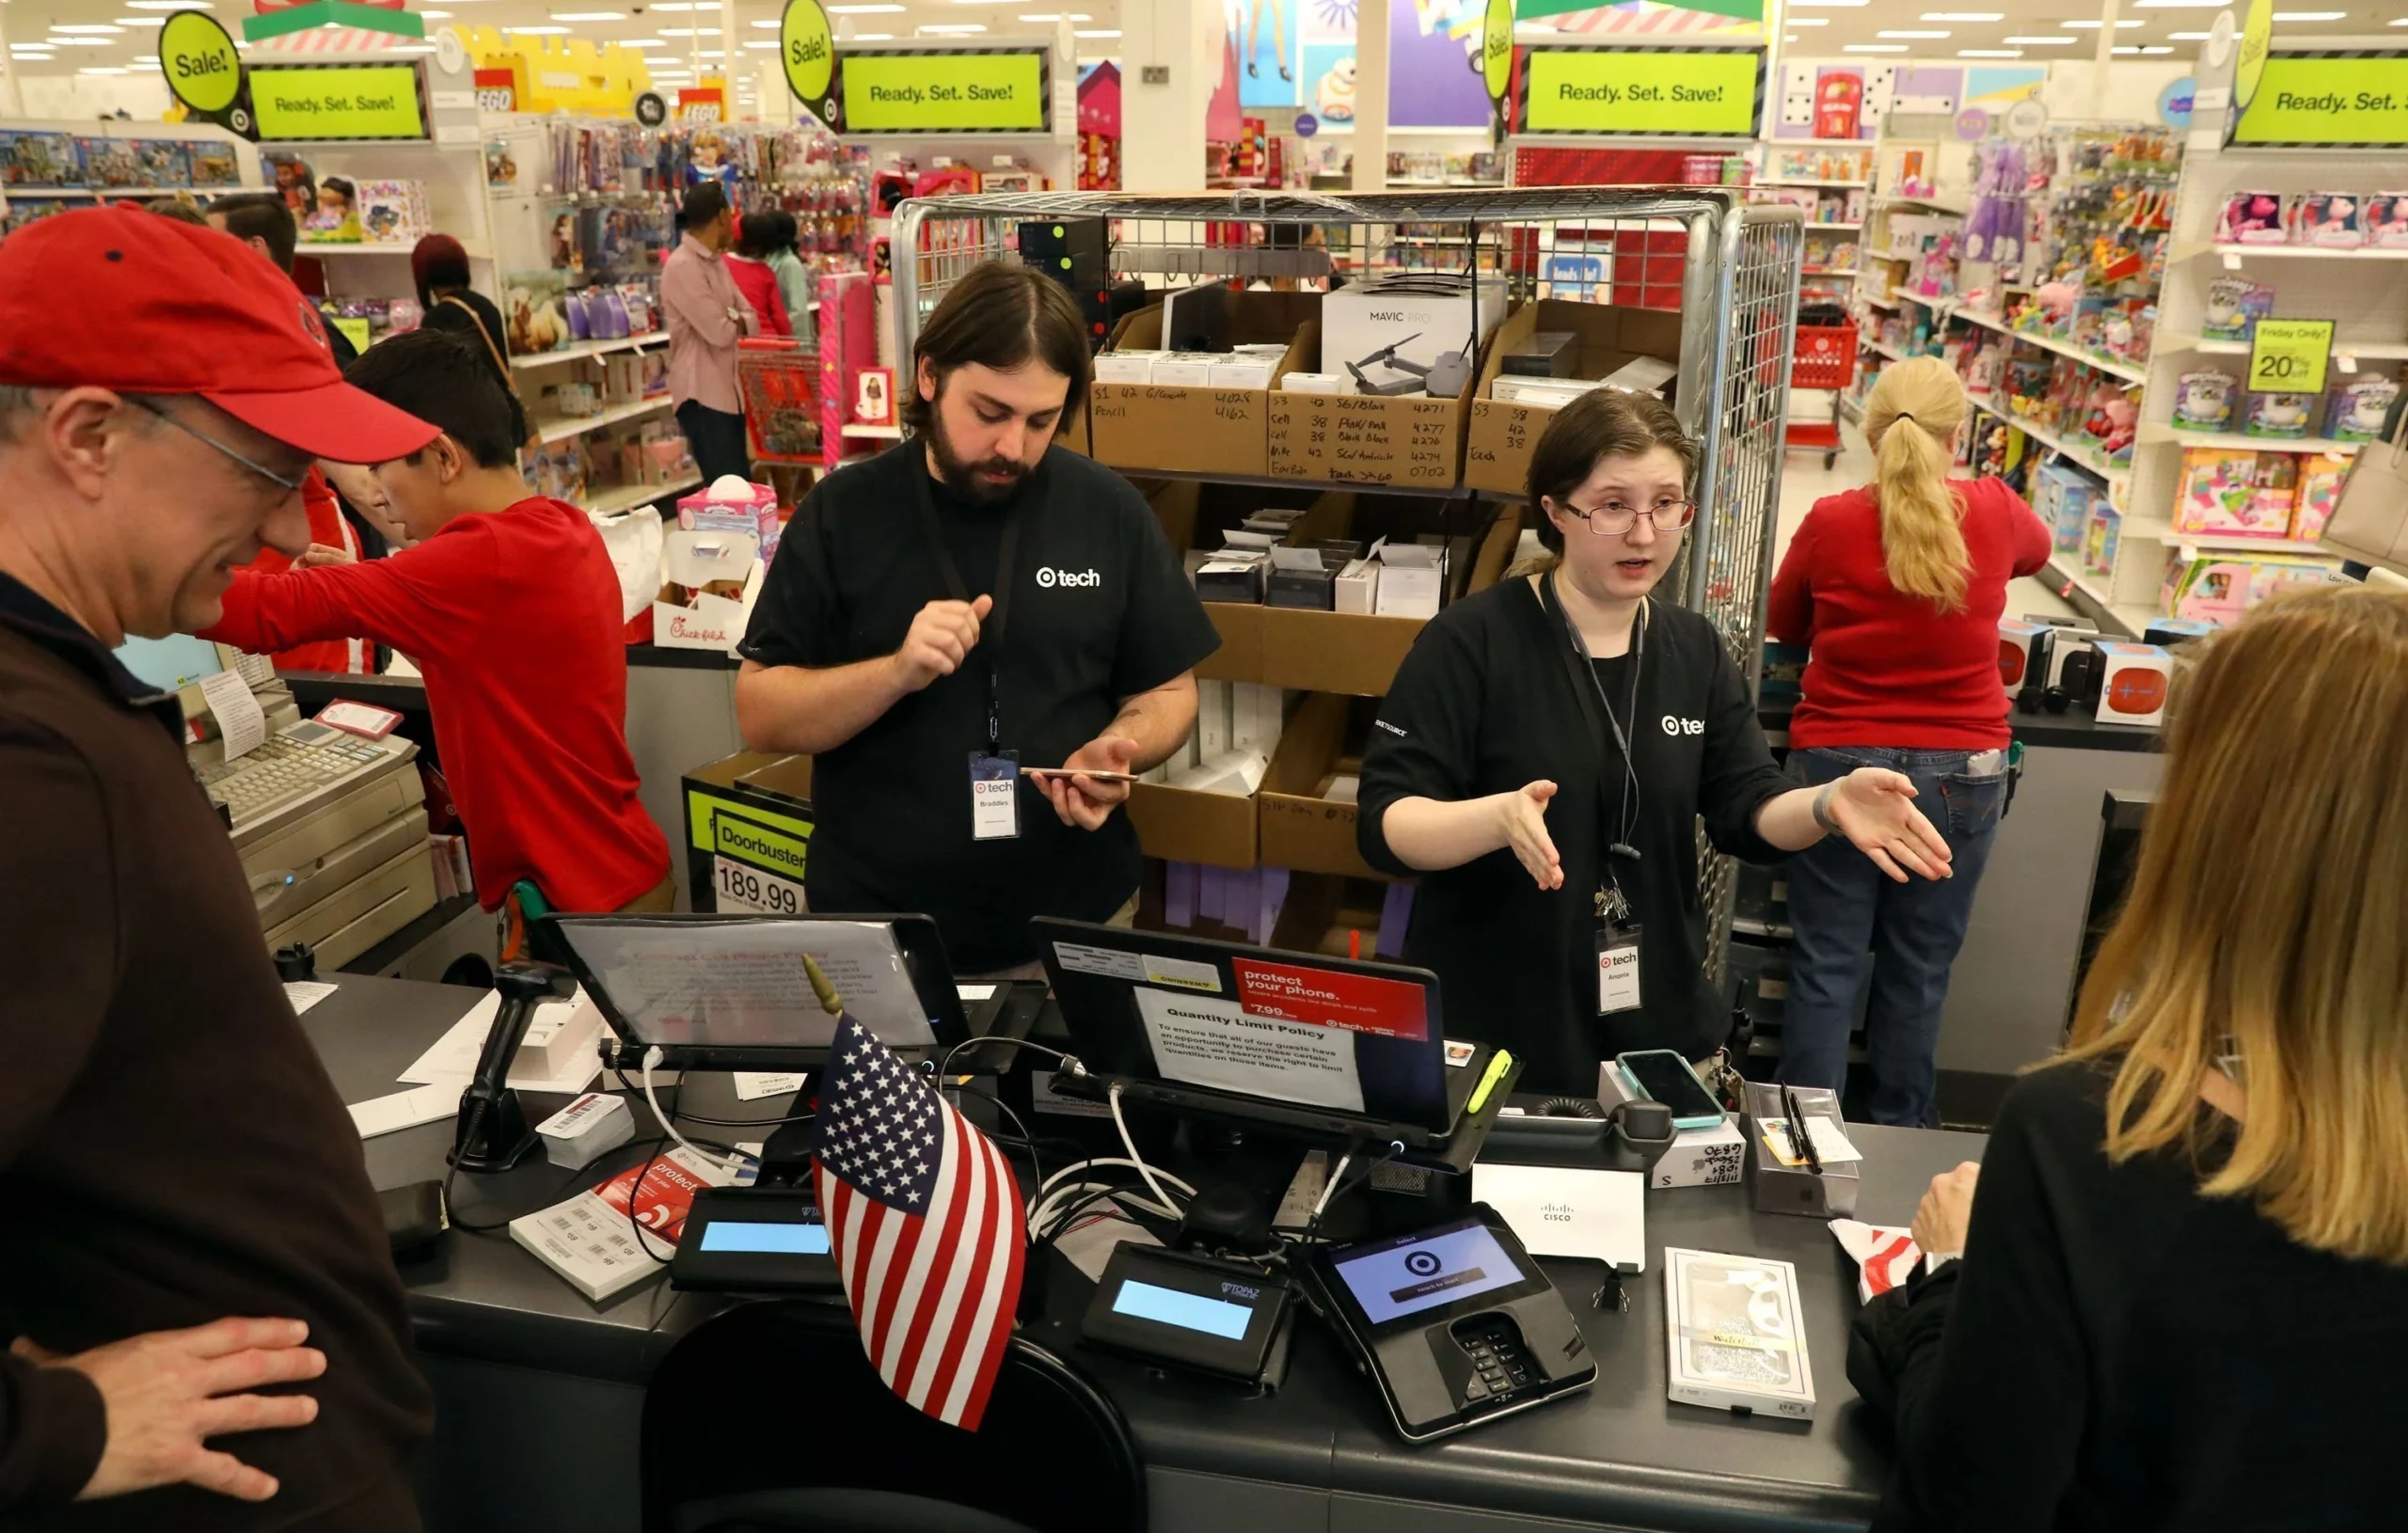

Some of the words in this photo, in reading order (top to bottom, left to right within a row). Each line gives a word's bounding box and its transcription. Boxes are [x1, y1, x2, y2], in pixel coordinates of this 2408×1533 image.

[791, 34, 826, 65] Sale!
[176, 49, 229, 78] Sale!
[870, 86, 925, 104] Ready.
[929, 86, 962, 102] Set.
[967, 84, 1013, 101] Save!
[1560, 84, 1622, 104] Ready.
[1627, 85, 1664, 101] Set.
[1671, 86, 1723, 103] Save!
[2276, 92, 2347, 114] Ready.
[2354, 92, 2398, 110] Set.
[275, 97, 322, 115] Ready.
[325, 97, 354, 111] Set.
[357, 96, 395, 111] Save!
[1370, 311, 1403, 322] MAVIC
[2259, 327, 2293, 340] Friday
[1215, 406, 1249, 419] 4162
[1512, 408, 1529, 421] 38
[1311, 415, 1327, 429] 38
[1413, 423, 1446, 435] 4277
[1412, 435, 1441, 445] 4276
[1506, 436, 1525, 449] 38
[1057, 568, 1100, 587] tech
[988, 782, 1013, 794] tech
[722, 826, 806, 868] Doorbuster
[720, 866, 797, 913] 189.99
[1612, 953, 1637, 966] tech
[1244, 971, 1302, 987] protect
[1245, 980, 1281, 993] your
[1286, 987, 1340, 1001] phone.
[1166, 1007, 1230, 1027] Quantity
[1235, 1019, 1274, 1032] Limit
[1277, 1025, 1325, 1040] Policy
[1339, 1019, 1364, 1032] tech
[1157, 1023, 1171, 1032] To
[1173, 1026, 1206, 1036] ensure
[1209, 1030, 1228, 1040] that
[1229, 1034, 1242, 1043] all
[1275, 1042, 1309, 1053] guests
[1312, 1046, 1337, 1057] have
[1175, 1035, 1230, 1050] opportunity
[1232, 1041, 1244, 1050] to
[1245, 1044, 1291, 1057] purchase
[1293, 1051, 1328, 1064] certain
[1164, 1046, 1212, 1060] quantities
[1228, 1055, 1256, 1067] those
[1258, 1061, 1289, 1071] items.
[1226, 1050, 1262, 1060] reserve
[1265, 1052, 1281, 1063] the
[1283, 1056, 1307, 1068] right
[1322, 1063, 1343, 1073] limit
[1704, 1143, 1742, 1157] 6870
[1544, 1213, 1571, 1222] CISCO
[1396, 1235, 1417, 1245] Select
[1230, 1284, 1260, 1298] TOPAZ
